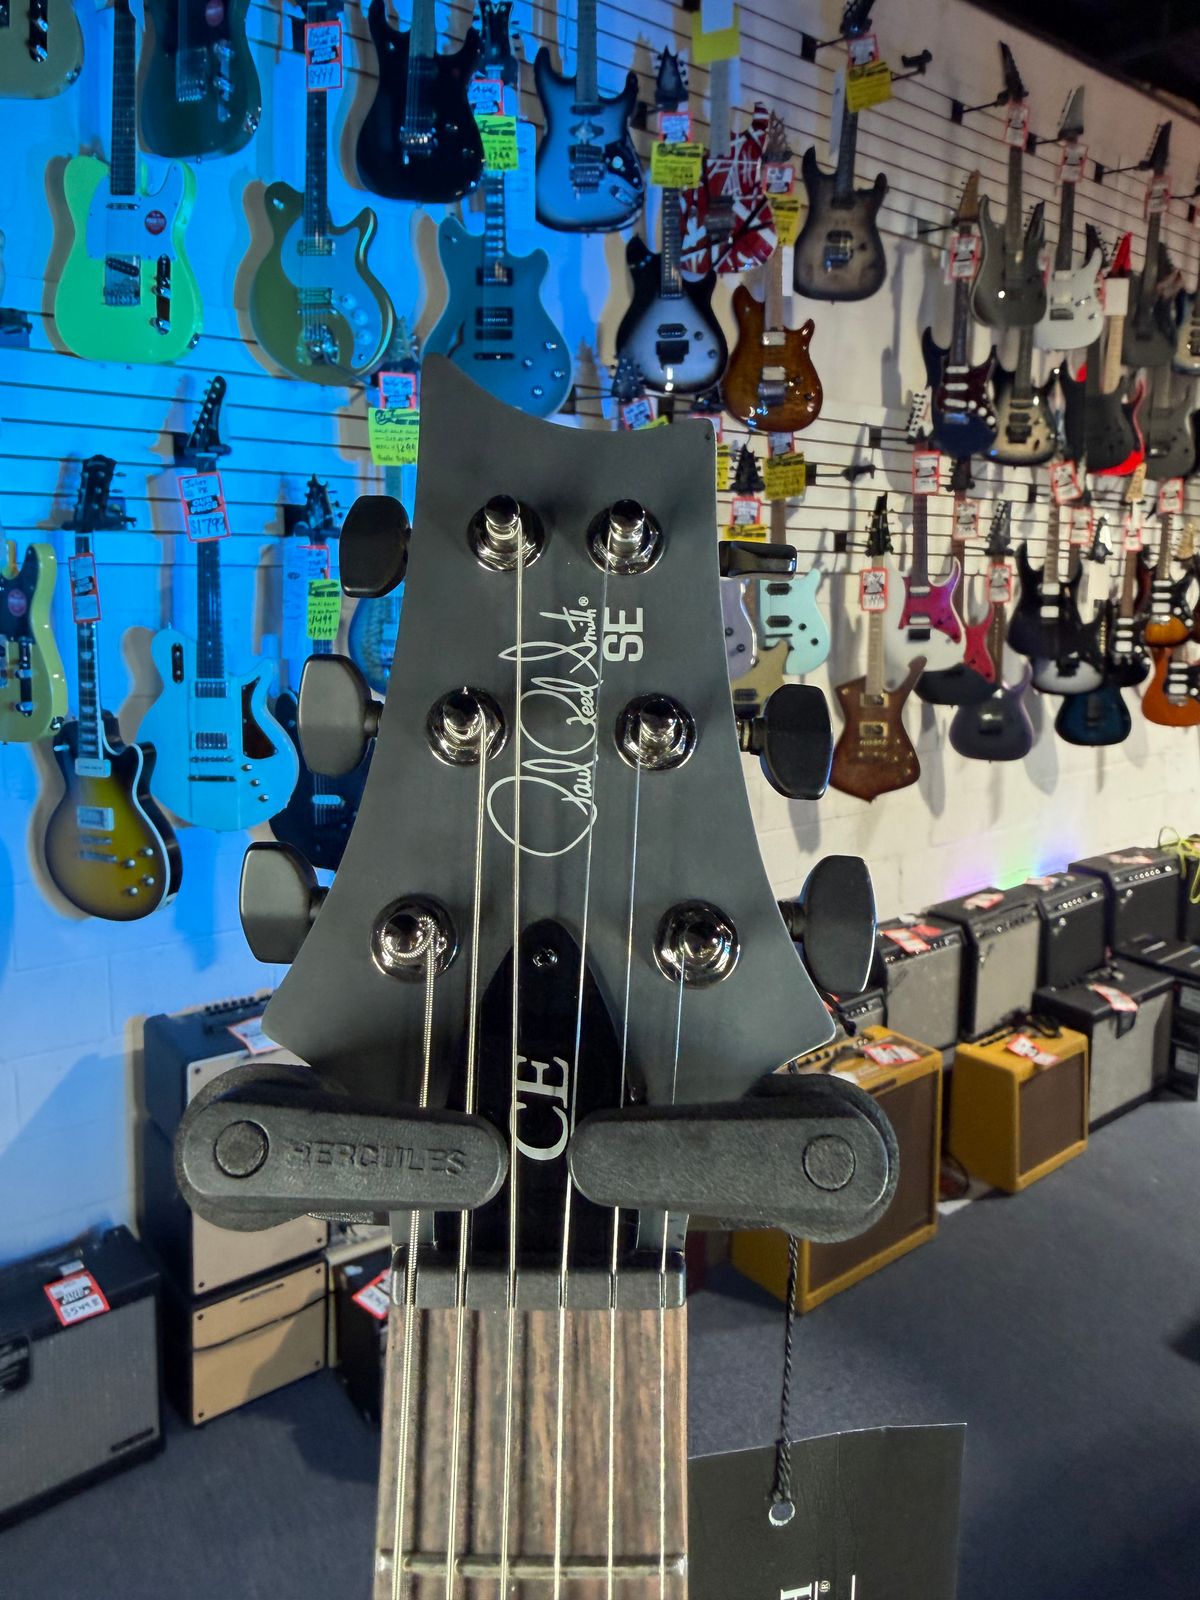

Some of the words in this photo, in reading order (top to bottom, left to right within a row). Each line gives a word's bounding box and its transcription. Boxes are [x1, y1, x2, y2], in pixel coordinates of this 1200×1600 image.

[603, 607, 643, 663] SE
[519, 677, 603, 756] Reed
[487, 753, 599, 857] Paul
[509, 1055, 569, 1160] CE
[286, 1140, 467, 1176] HERCULES
